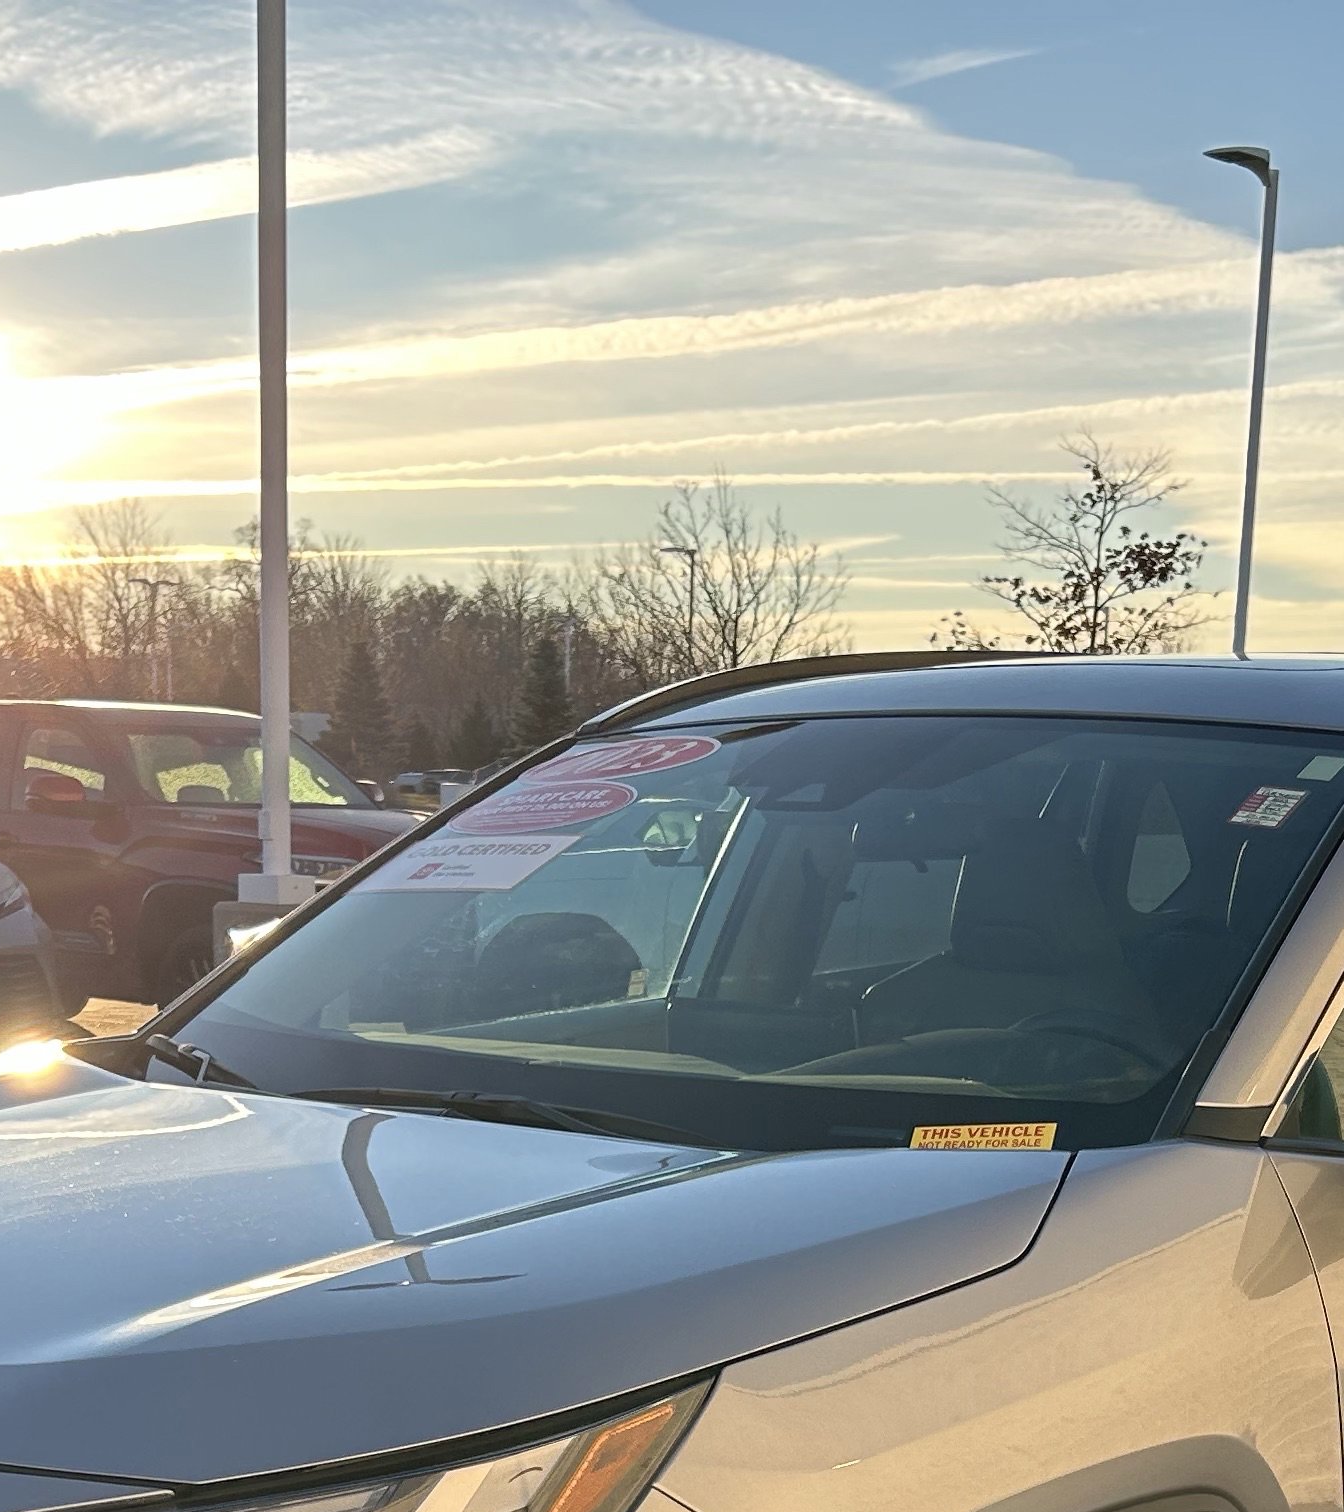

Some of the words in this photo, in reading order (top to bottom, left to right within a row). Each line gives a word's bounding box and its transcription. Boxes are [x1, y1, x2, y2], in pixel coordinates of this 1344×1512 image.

[499, 791, 563, 806] SMART
[559, 789, 611, 800] CARE
[408, 845, 460, 858] GOLD
[457, 844, 552, 856] CERTIFIED
[921, 1128, 962, 1140] THIS
[968, 1126, 1046, 1138] VEHICLE
[918, 1141, 944, 1149] NOT
[944, 1140, 983, 1149] READY
[984, 1139, 1008, 1148] FOR
[1012, 1139, 1042, 1148] SALE
